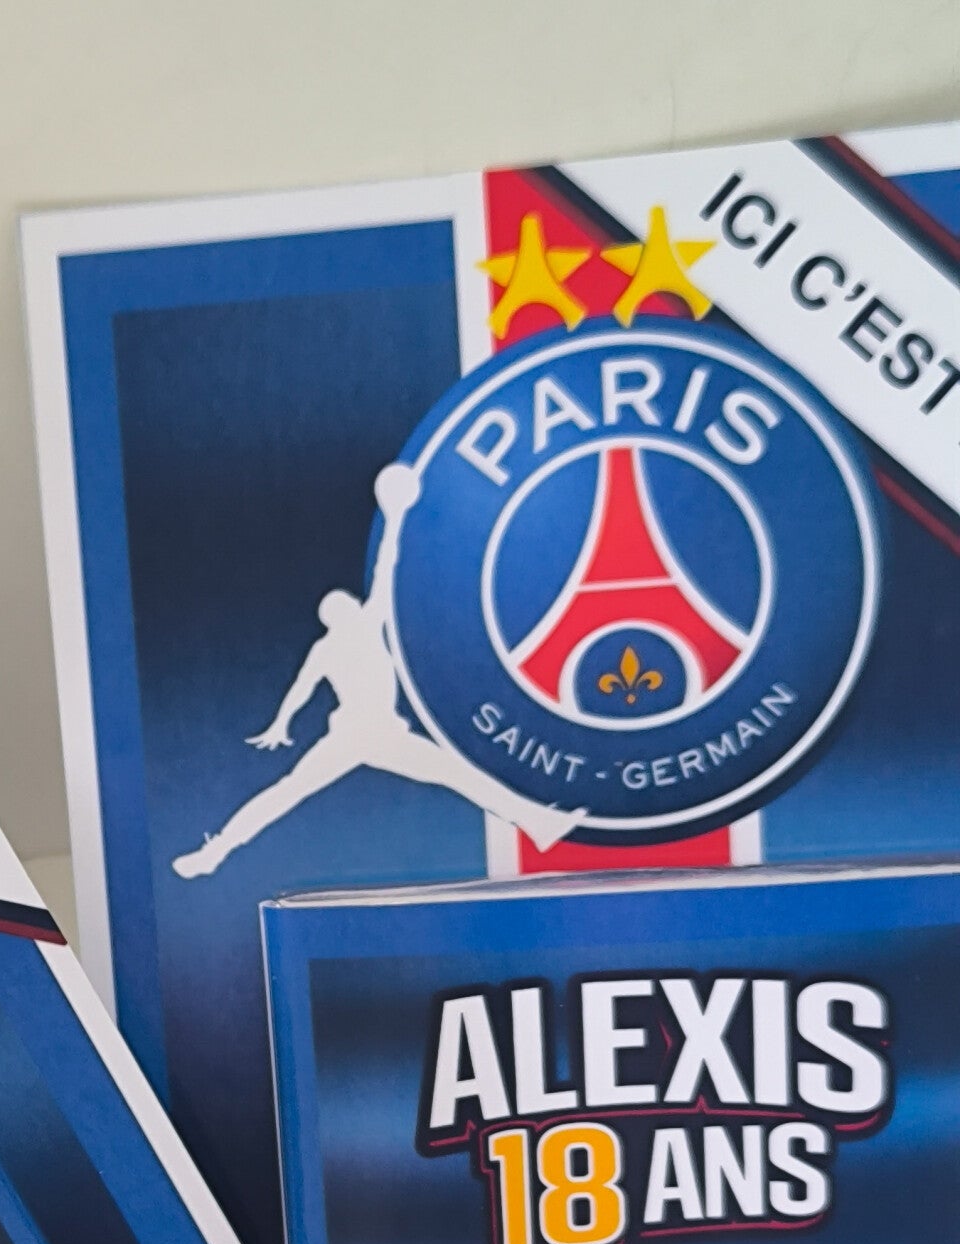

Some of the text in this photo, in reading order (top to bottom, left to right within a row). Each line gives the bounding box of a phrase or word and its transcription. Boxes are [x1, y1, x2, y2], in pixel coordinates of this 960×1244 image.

[698, 173, 798, 269] ICI
[454, 358, 782, 487] PARIS
[471, 702, 586, 784] SAINT
[621, 683, 794, 791] GERMAIN
[429, 978, 887, 1129] ALEXIS
[643, 1121, 833, 1224] ANS
